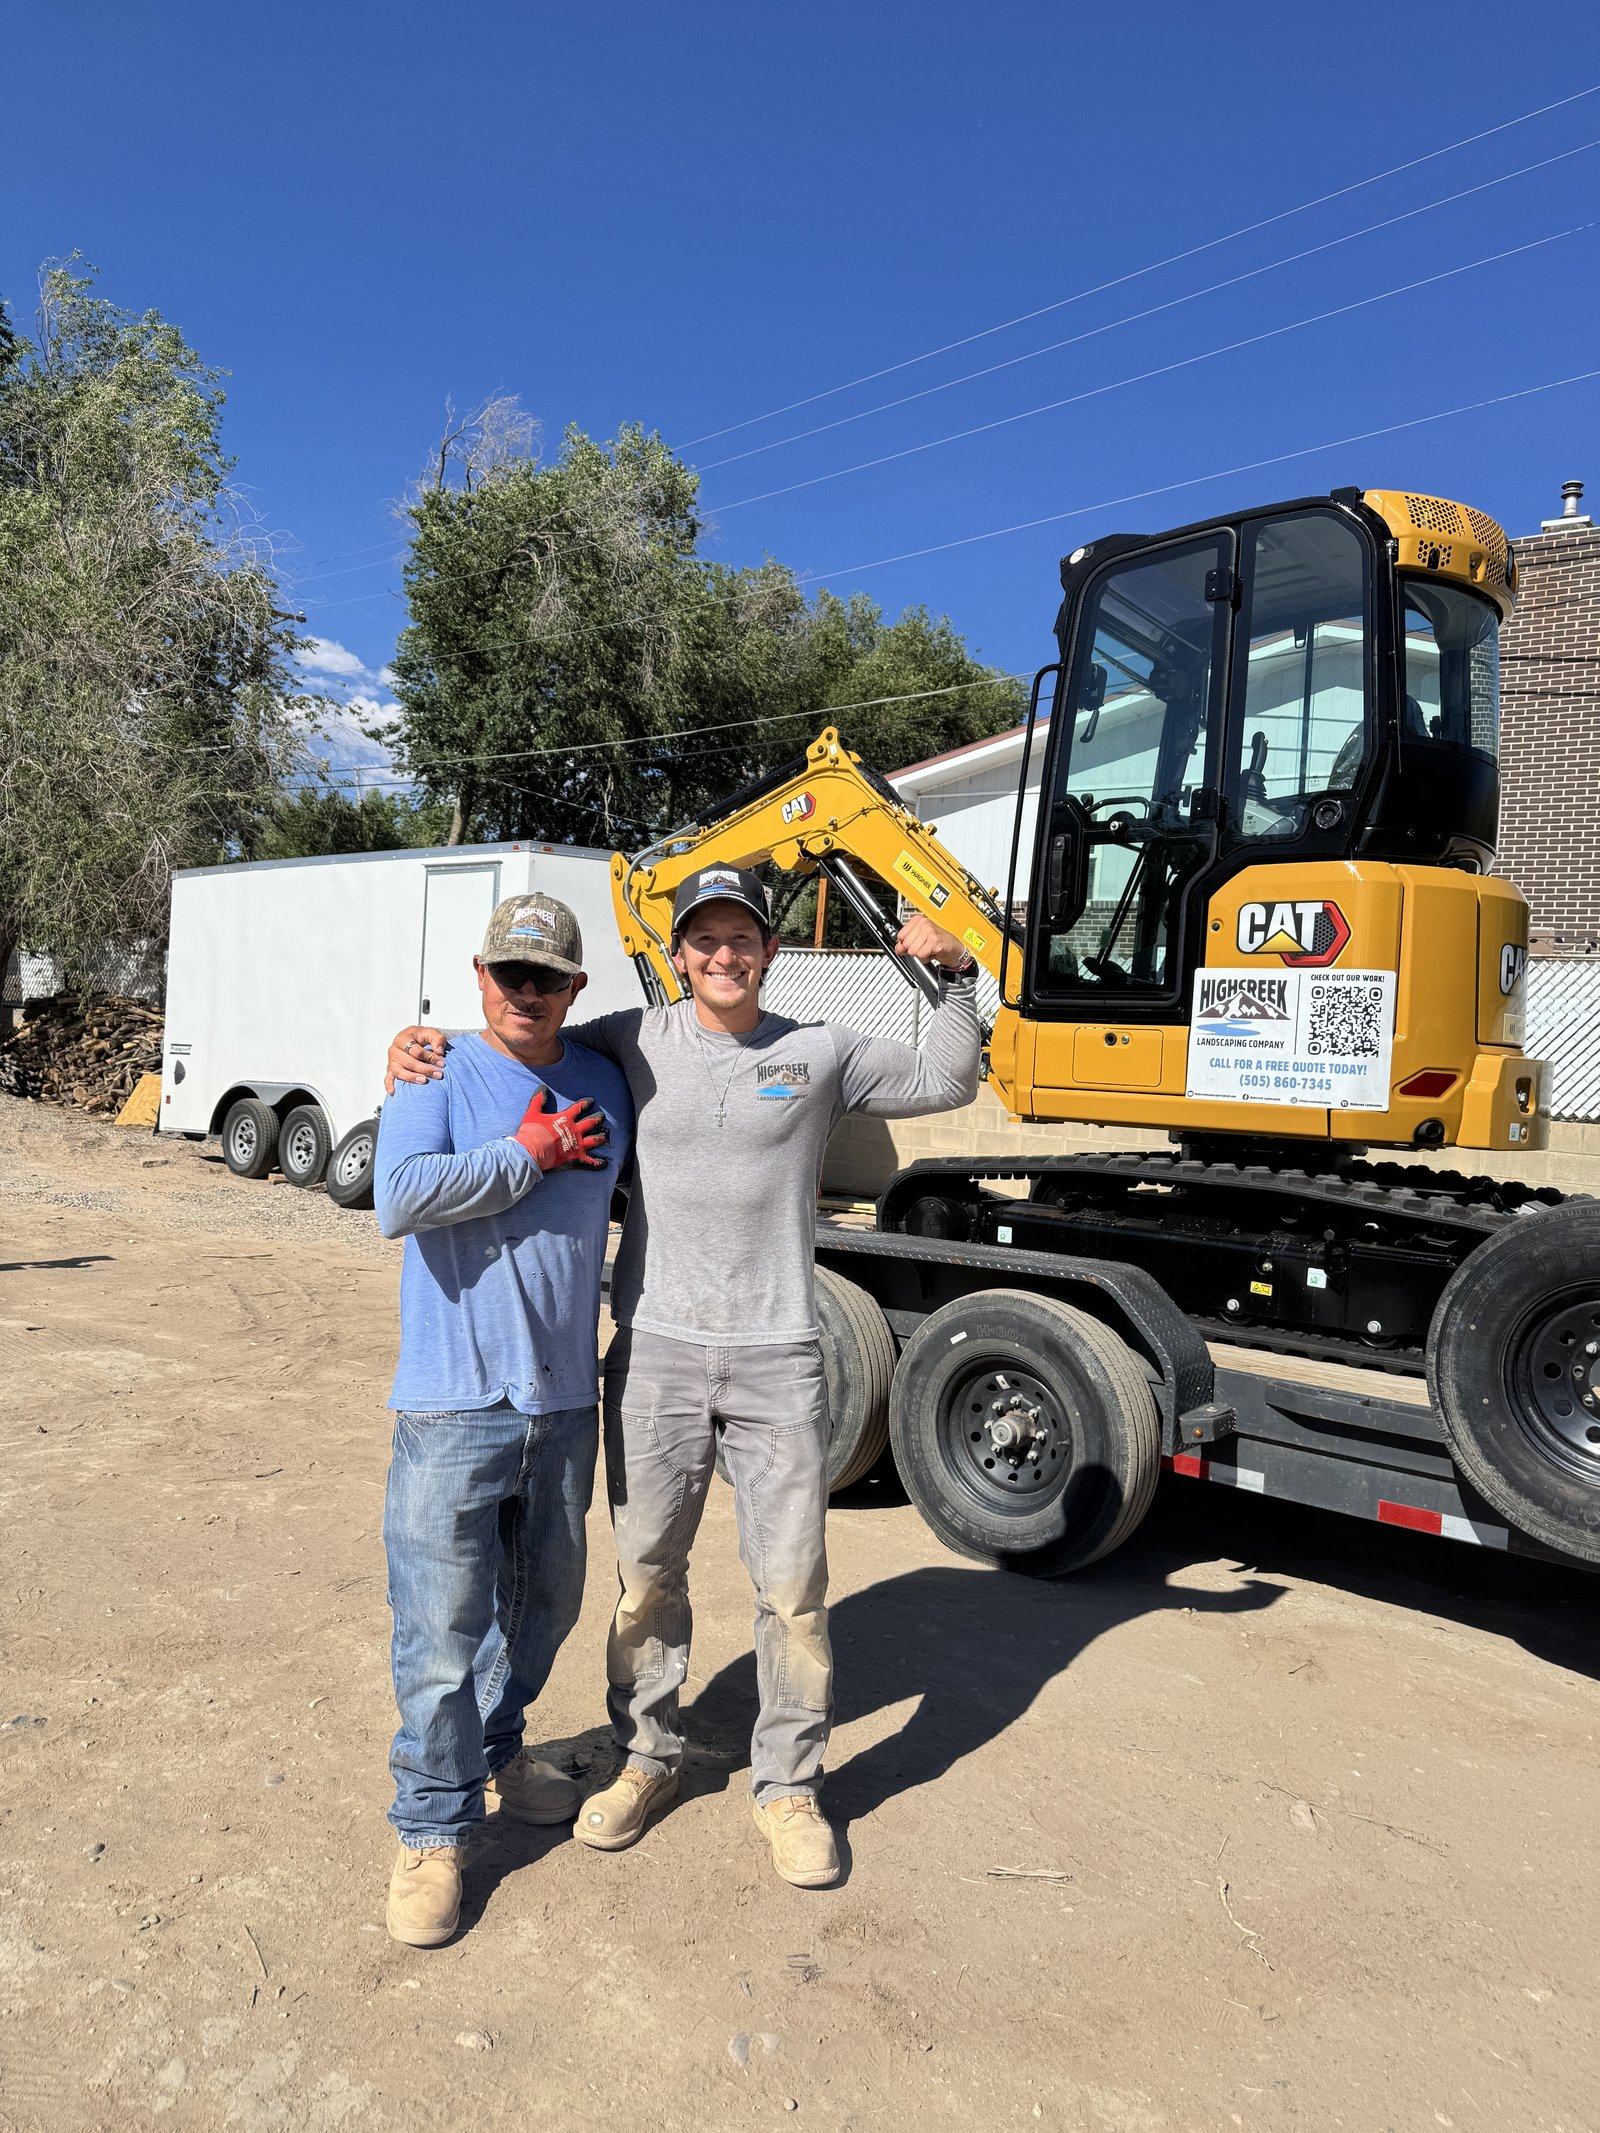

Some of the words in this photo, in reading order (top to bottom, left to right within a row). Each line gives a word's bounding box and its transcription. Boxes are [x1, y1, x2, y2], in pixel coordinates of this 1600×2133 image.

[781, 793, 808, 824] CAT
[910, 868, 932, 890] WAGNER
[931, 887, 948, 904] CAT
[1238, 901, 1324, 953] CAT
[1310, 973, 1330, 981] CHECK
[1362, 975, 1385, 983] WORK!
[1199, 978, 1288, 1015] HIGHCREEK
[1196, 1037, 1247, 1048] LANDSCAPING
[1248, 1039, 1285, 1049] COMPANY
[756, 1062, 810, 1084] HIGHCREEK
[1209, 1057, 1231, 1069] CALL
[1234, 1058, 1252, 1070] FOR
[1255, 1060, 1263, 1070] A
[1265, 1060, 1290, 1072] FREE
[1292, 1061, 1326, 1074] QUOTE
[1328, 1063, 1368, 1076] TODAY!
[1239, 1074, 1271, 1088] (505)
[1273, 1075, 1333, 1091] 860-7345
[938, 1501, 1054, 1549] HERCULES
